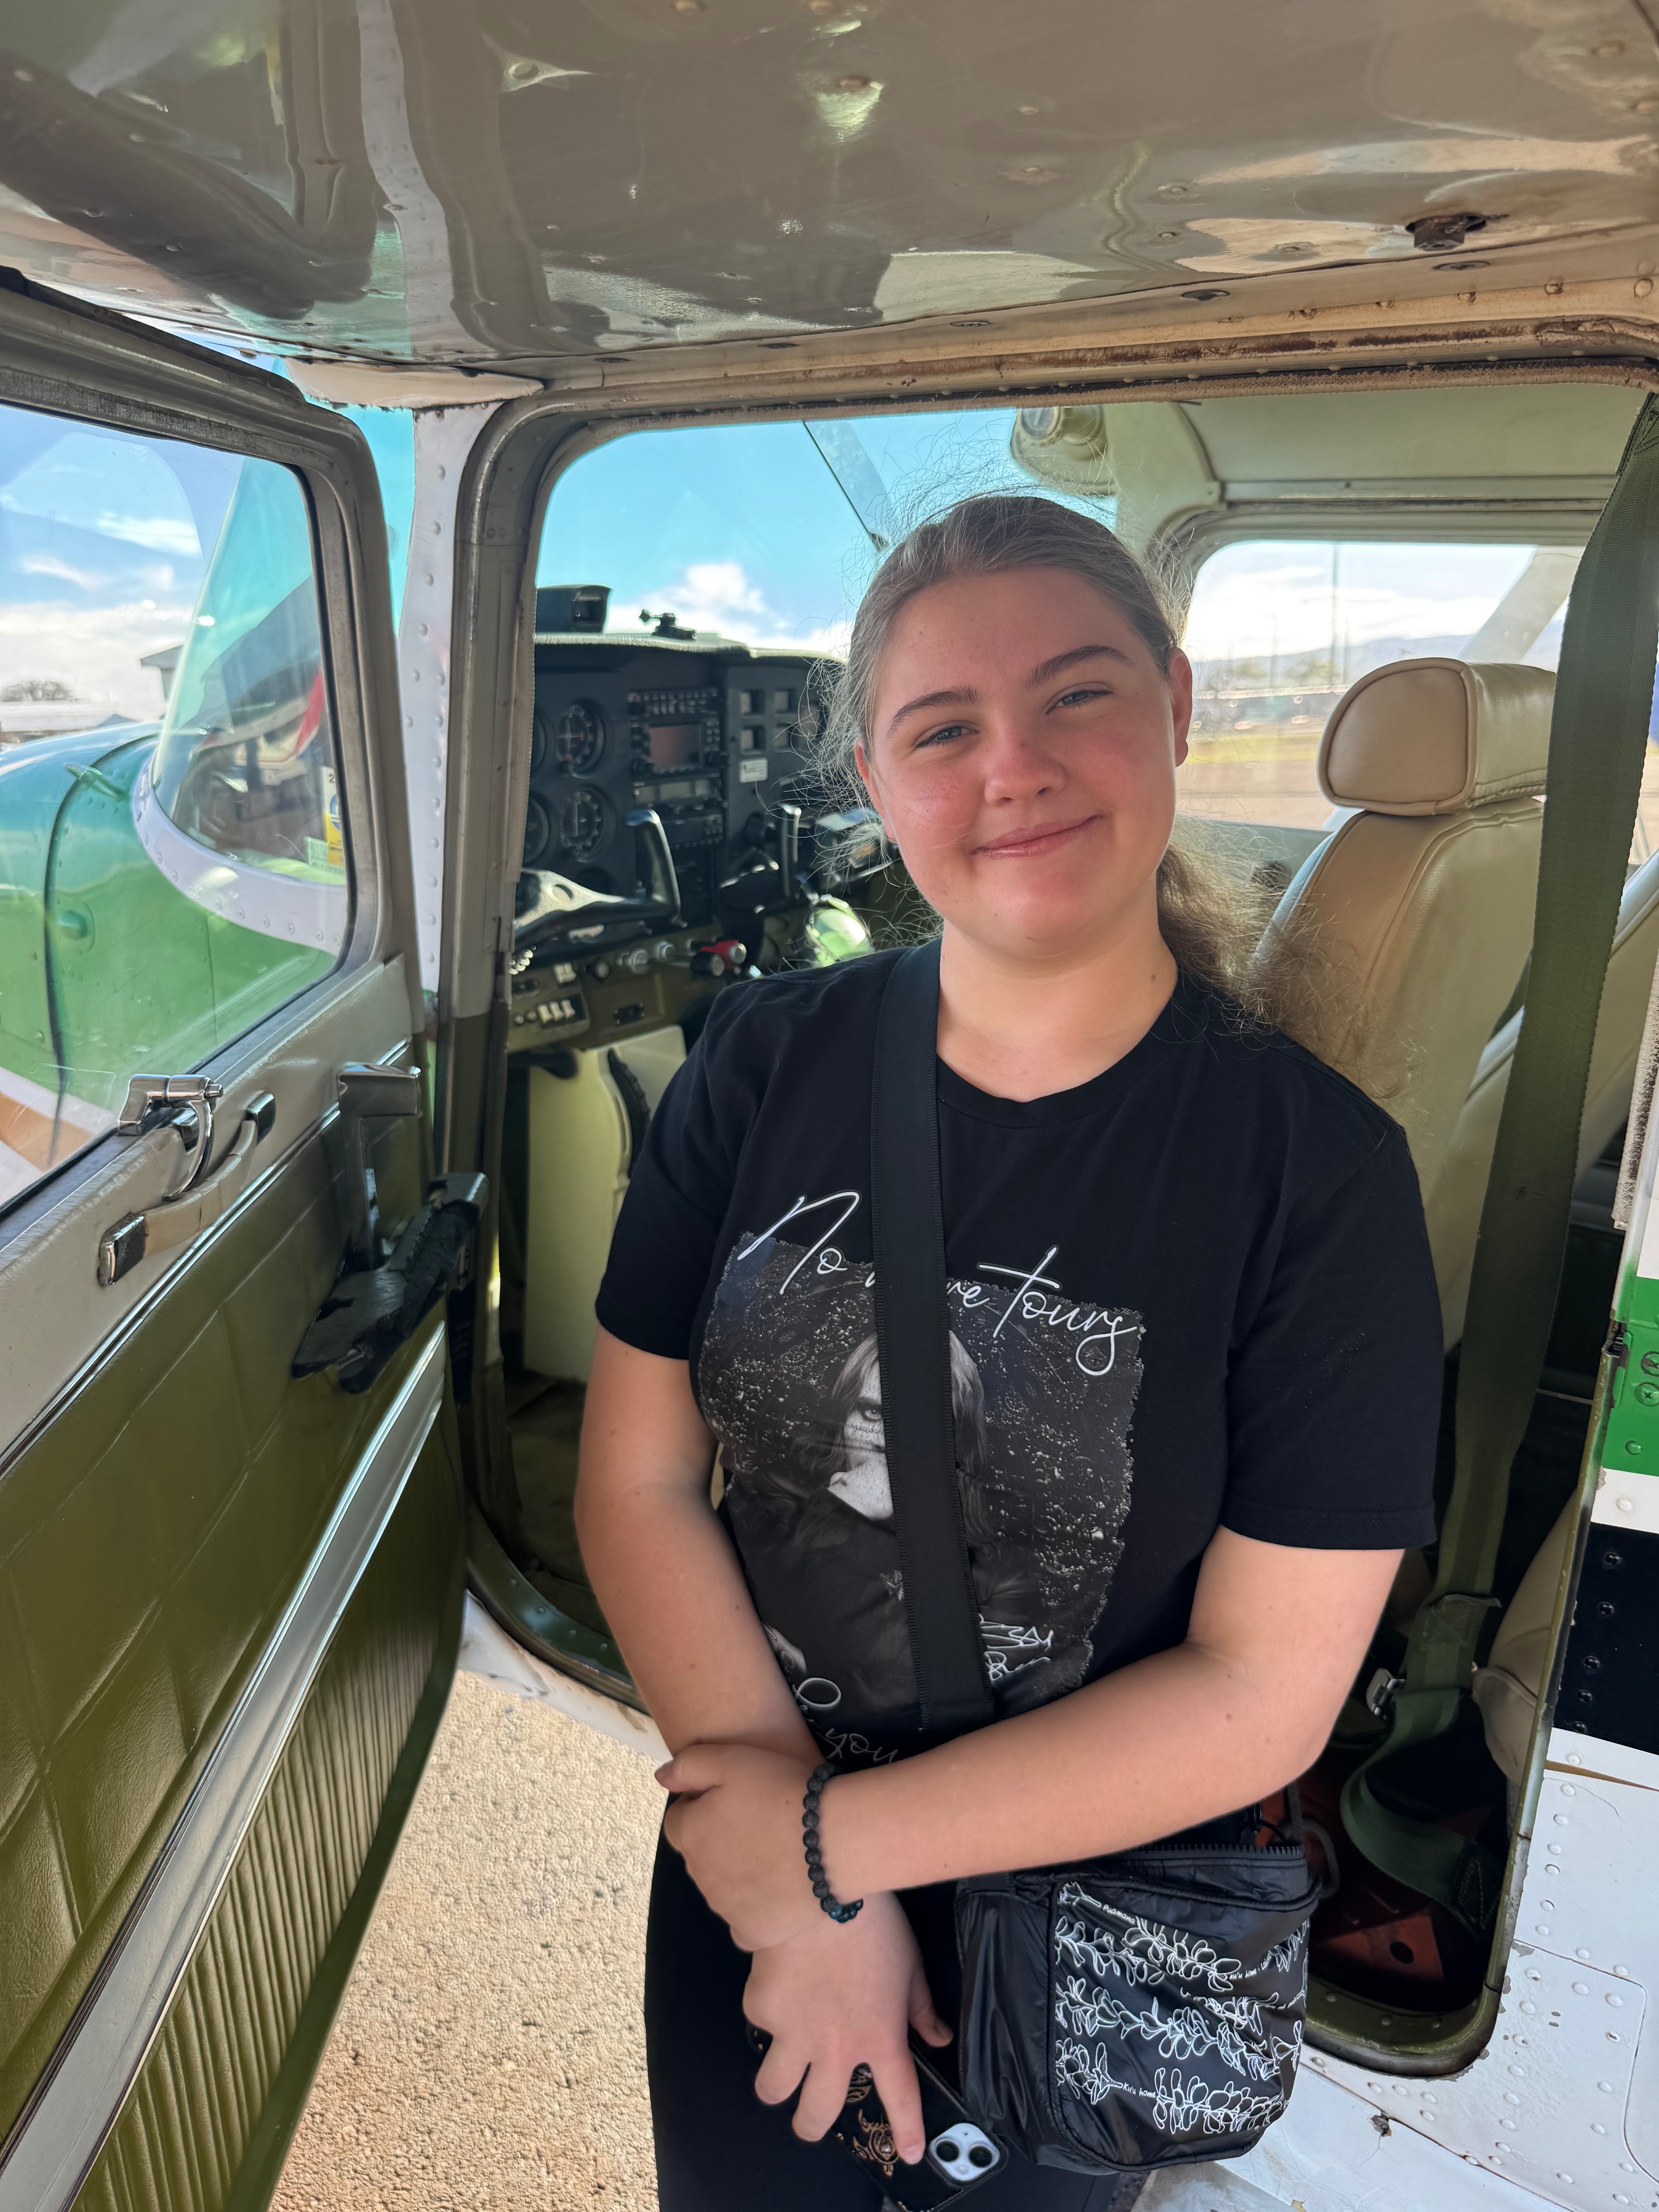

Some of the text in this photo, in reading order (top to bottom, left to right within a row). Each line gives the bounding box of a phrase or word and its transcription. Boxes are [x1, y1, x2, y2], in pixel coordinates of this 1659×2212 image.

[865, 1271, 991, 1308] re
[1103, 1904, 1135, 1925] Puamana
[1139, 2087, 1156, 2098] home
